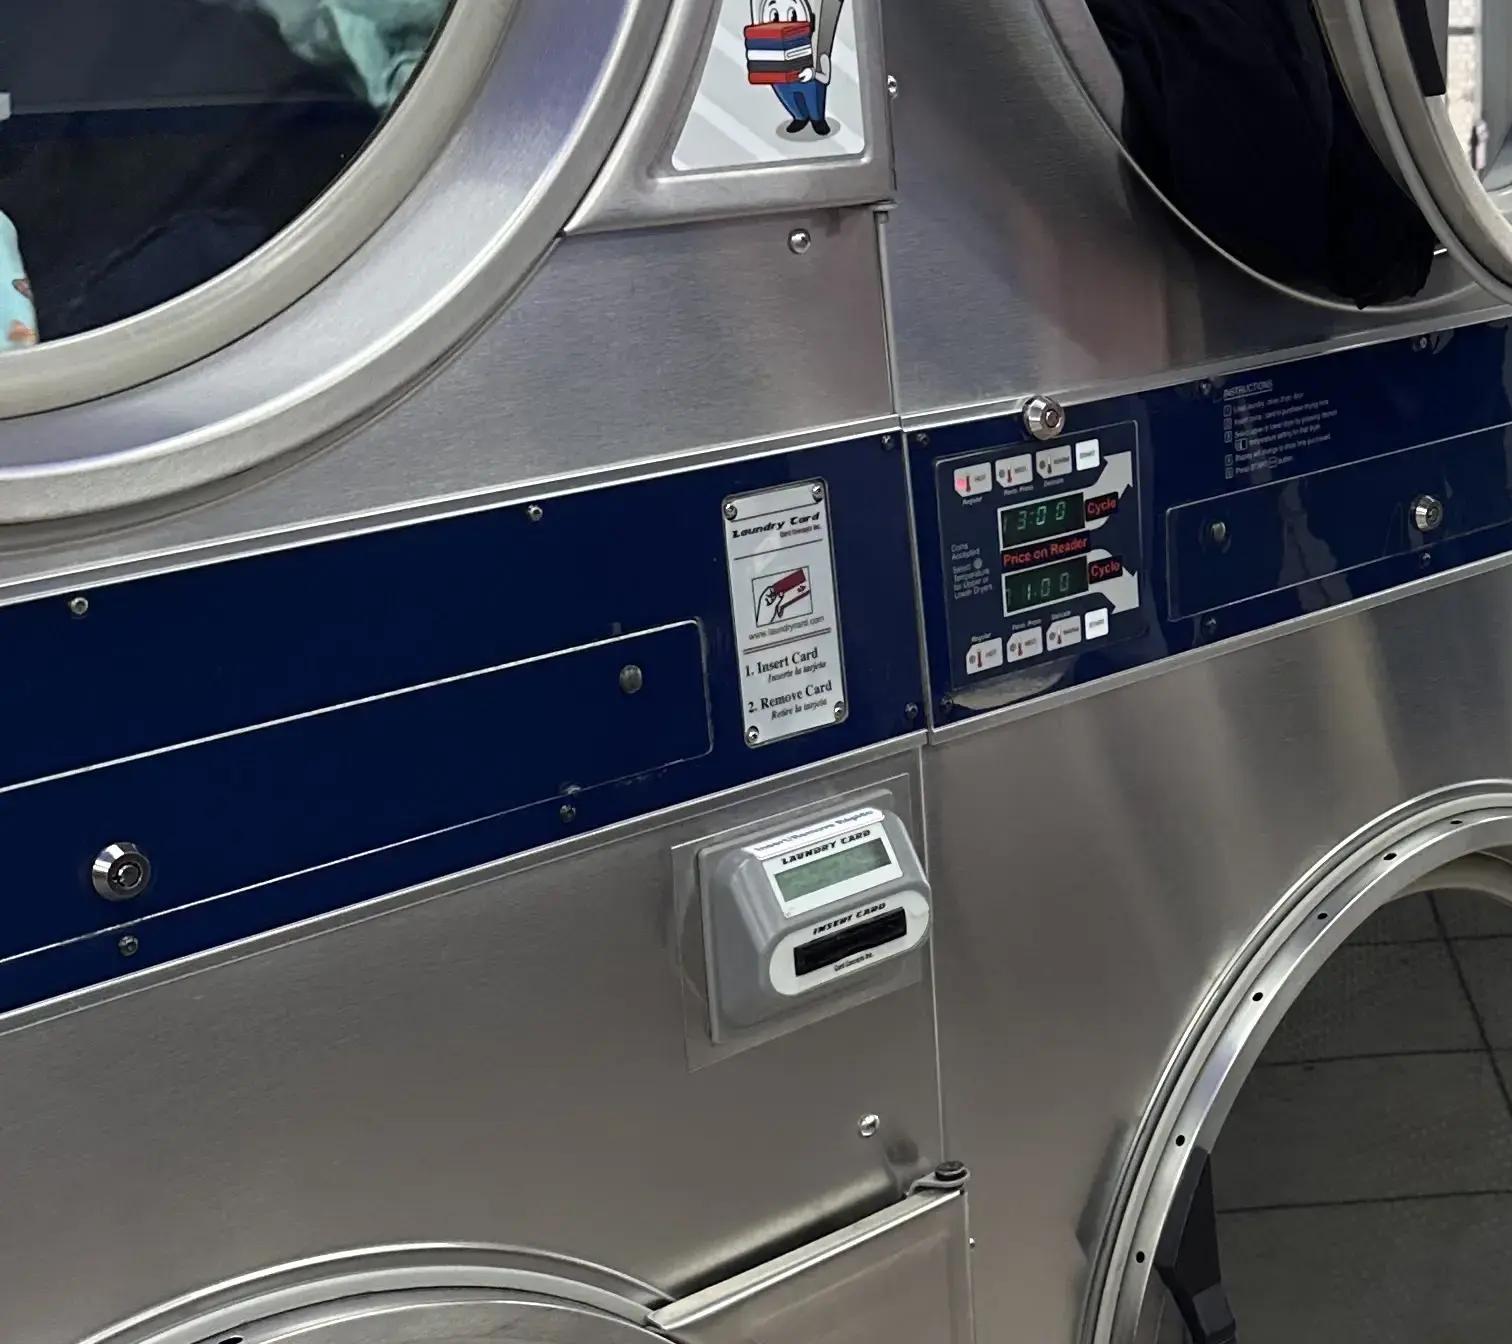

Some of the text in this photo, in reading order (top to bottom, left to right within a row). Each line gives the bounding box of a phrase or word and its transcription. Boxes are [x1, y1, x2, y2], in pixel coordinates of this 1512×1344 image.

[1087, 498, 1117, 516] Cycle
[732, 512, 820, 538] Laundry Card
[1003, 537, 1087, 567] Price on Reader
[1090, 561, 1121, 579] Cycle
[745, 646, 818, 677] 1. Insert Card
[748, 680, 833, 713] 2. Remove Card
[782, 829, 871, 865] LAUNDRY CARD
[812, 902, 886, 935] INSERT CARD
